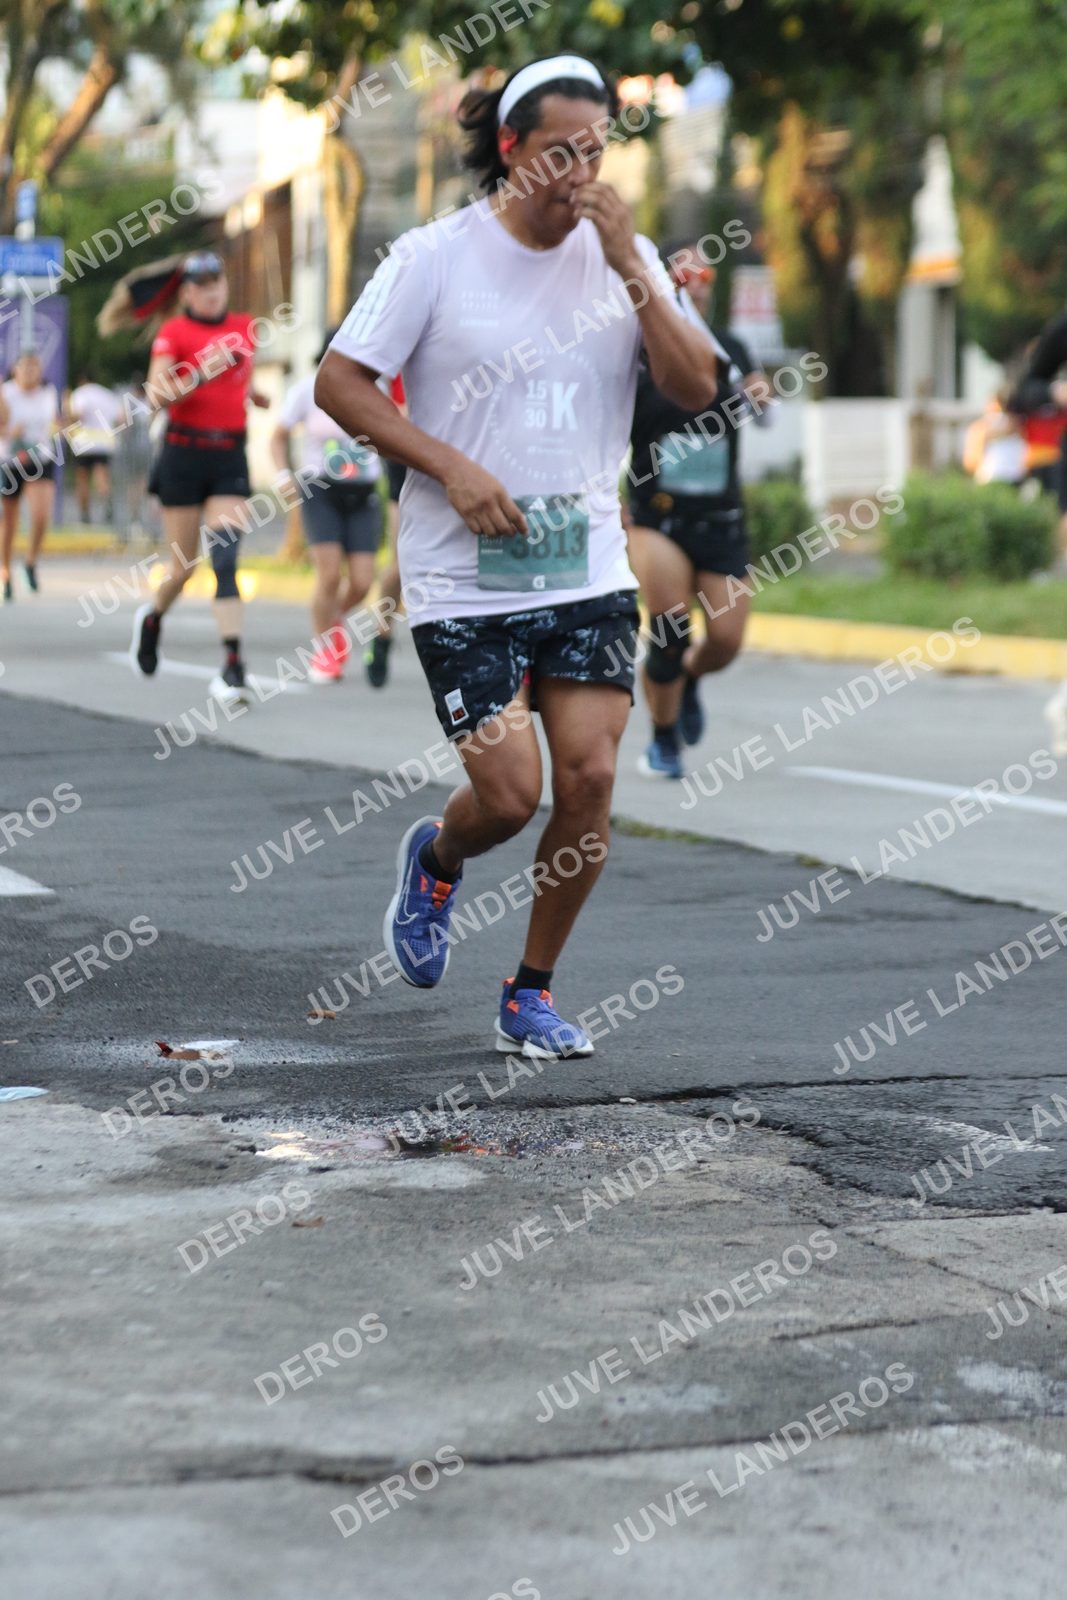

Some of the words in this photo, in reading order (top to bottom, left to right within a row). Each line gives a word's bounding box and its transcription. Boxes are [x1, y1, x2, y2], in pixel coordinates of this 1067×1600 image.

[526, 380, 547, 400] 15
[551, 381, 581, 433] K
[525, 409, 547, 429] 30
